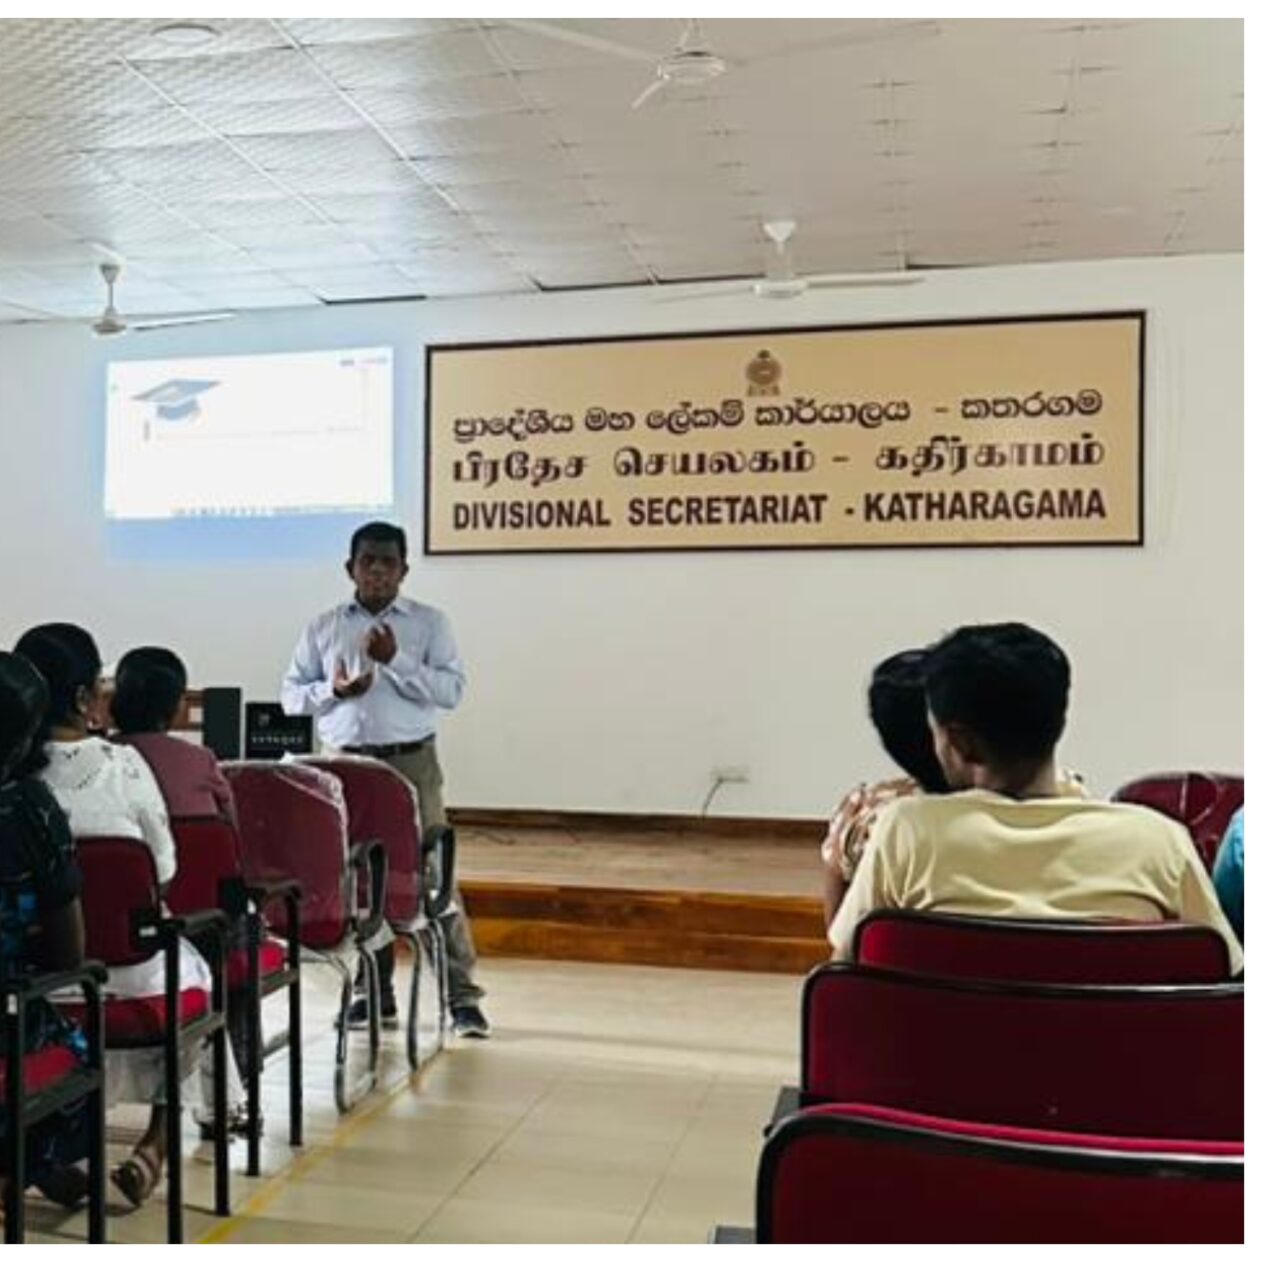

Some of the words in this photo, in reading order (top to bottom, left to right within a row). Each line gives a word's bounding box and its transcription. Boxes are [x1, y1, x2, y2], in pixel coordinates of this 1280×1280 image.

[585, 407, 636, 431] මහ
[646, 400, 745, 435] ලේකම්
[754, 397, 911, 429] කාර්යාලය
[960, 388, 1103, 420] කතරගම
[453, 450, 587, 488] பிரதேச
[614, 441, 815, 477] செயலகம்
[875, 432, 1105, 477] கதிர்காமம்
[453, 498, 611, 530] DIVISIONAL
[628, 493, 828, 527] SECRETARIAT
[864, 488, 1107, 522] KATHARAGAMA
